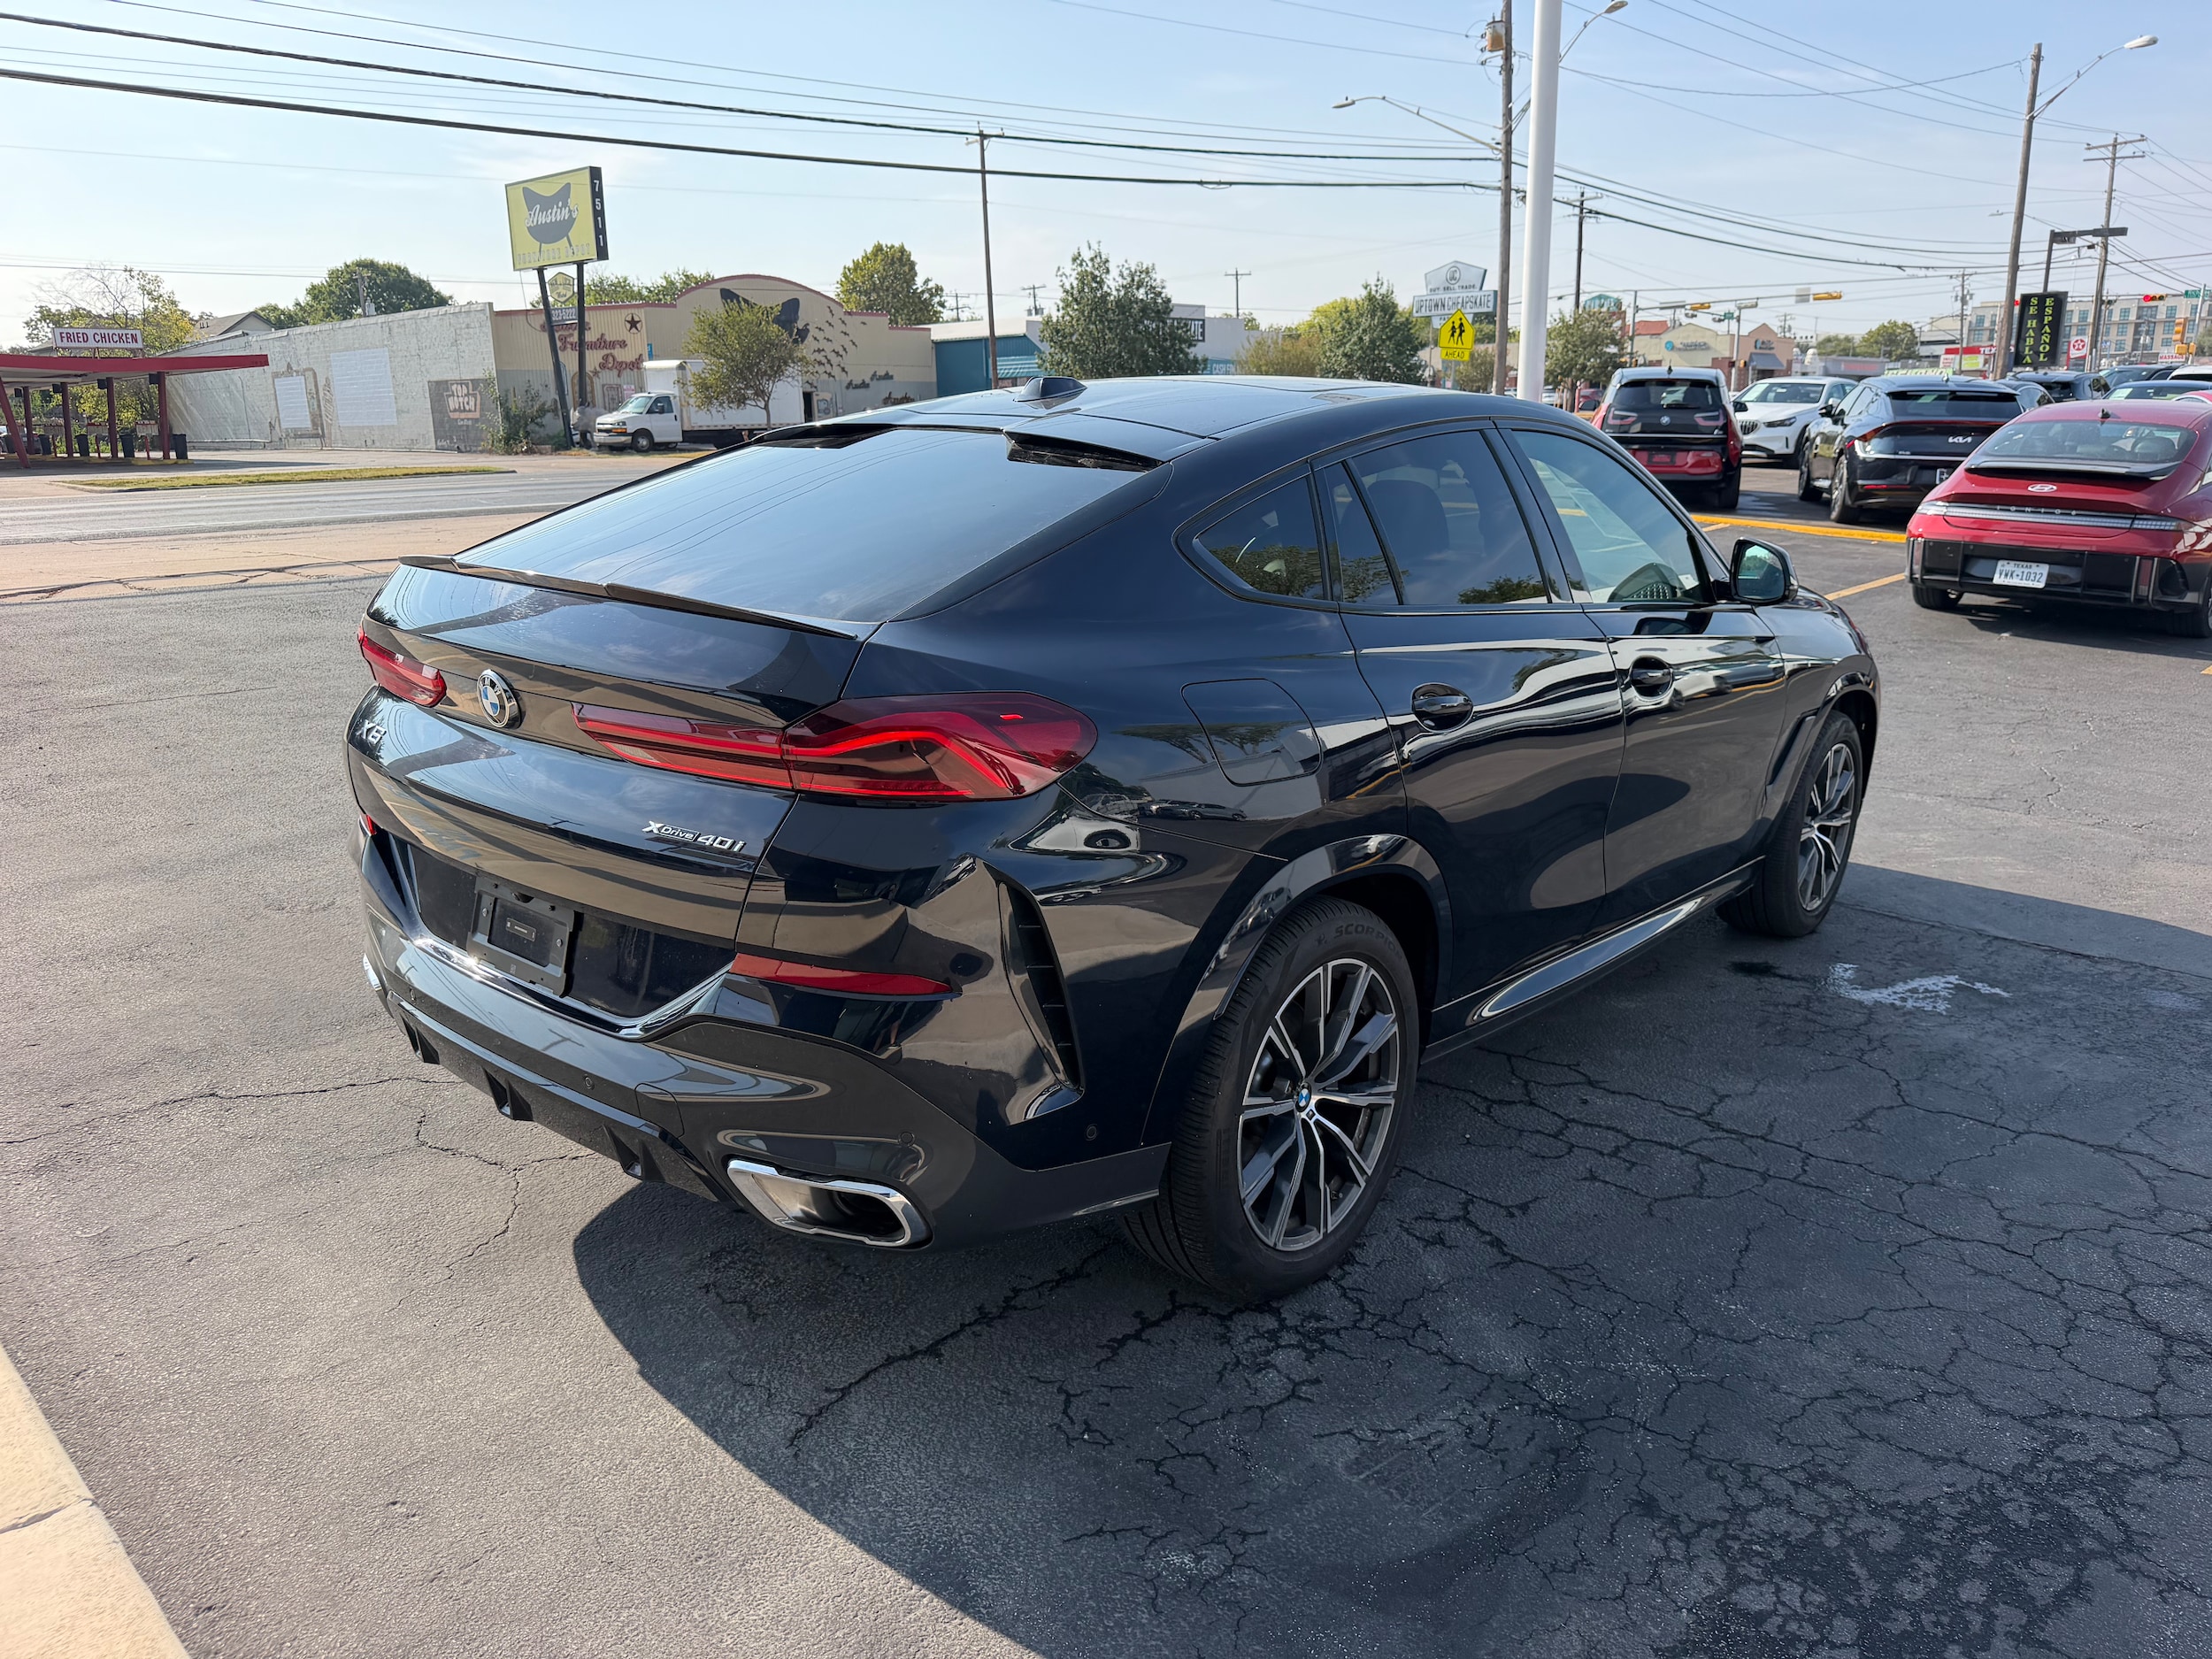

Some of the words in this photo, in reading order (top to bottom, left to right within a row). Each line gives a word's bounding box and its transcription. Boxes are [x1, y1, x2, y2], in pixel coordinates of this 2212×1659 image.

[526, 198, 579, 227] Austin's
[593, 180, 603, 247] 7511
[1416, 298, 1447, 313] UPTOWN
[1447, 295, 1492, 311] CHEAPSKATE
[2029, 296, 2039, 315] SE
[59, 332, 88, 343] FRIED
[93, 333, 138, 344] CHICKEN
[2039, 297, 2055, 362] ESPAÑOL
[1979, 345, 2015, 354] TEXO
[2023, 319, 2037, 364] HABLA
[1445, 350, 1465, 359] AHEAD
[599, 352, 644, 378] Depot
[452, 384, 467, 396] TOP
[448, 396, 475, 411] NOTCH
[479, 676, 501, 695] BMW
[356, 719, 387, 745] X6
